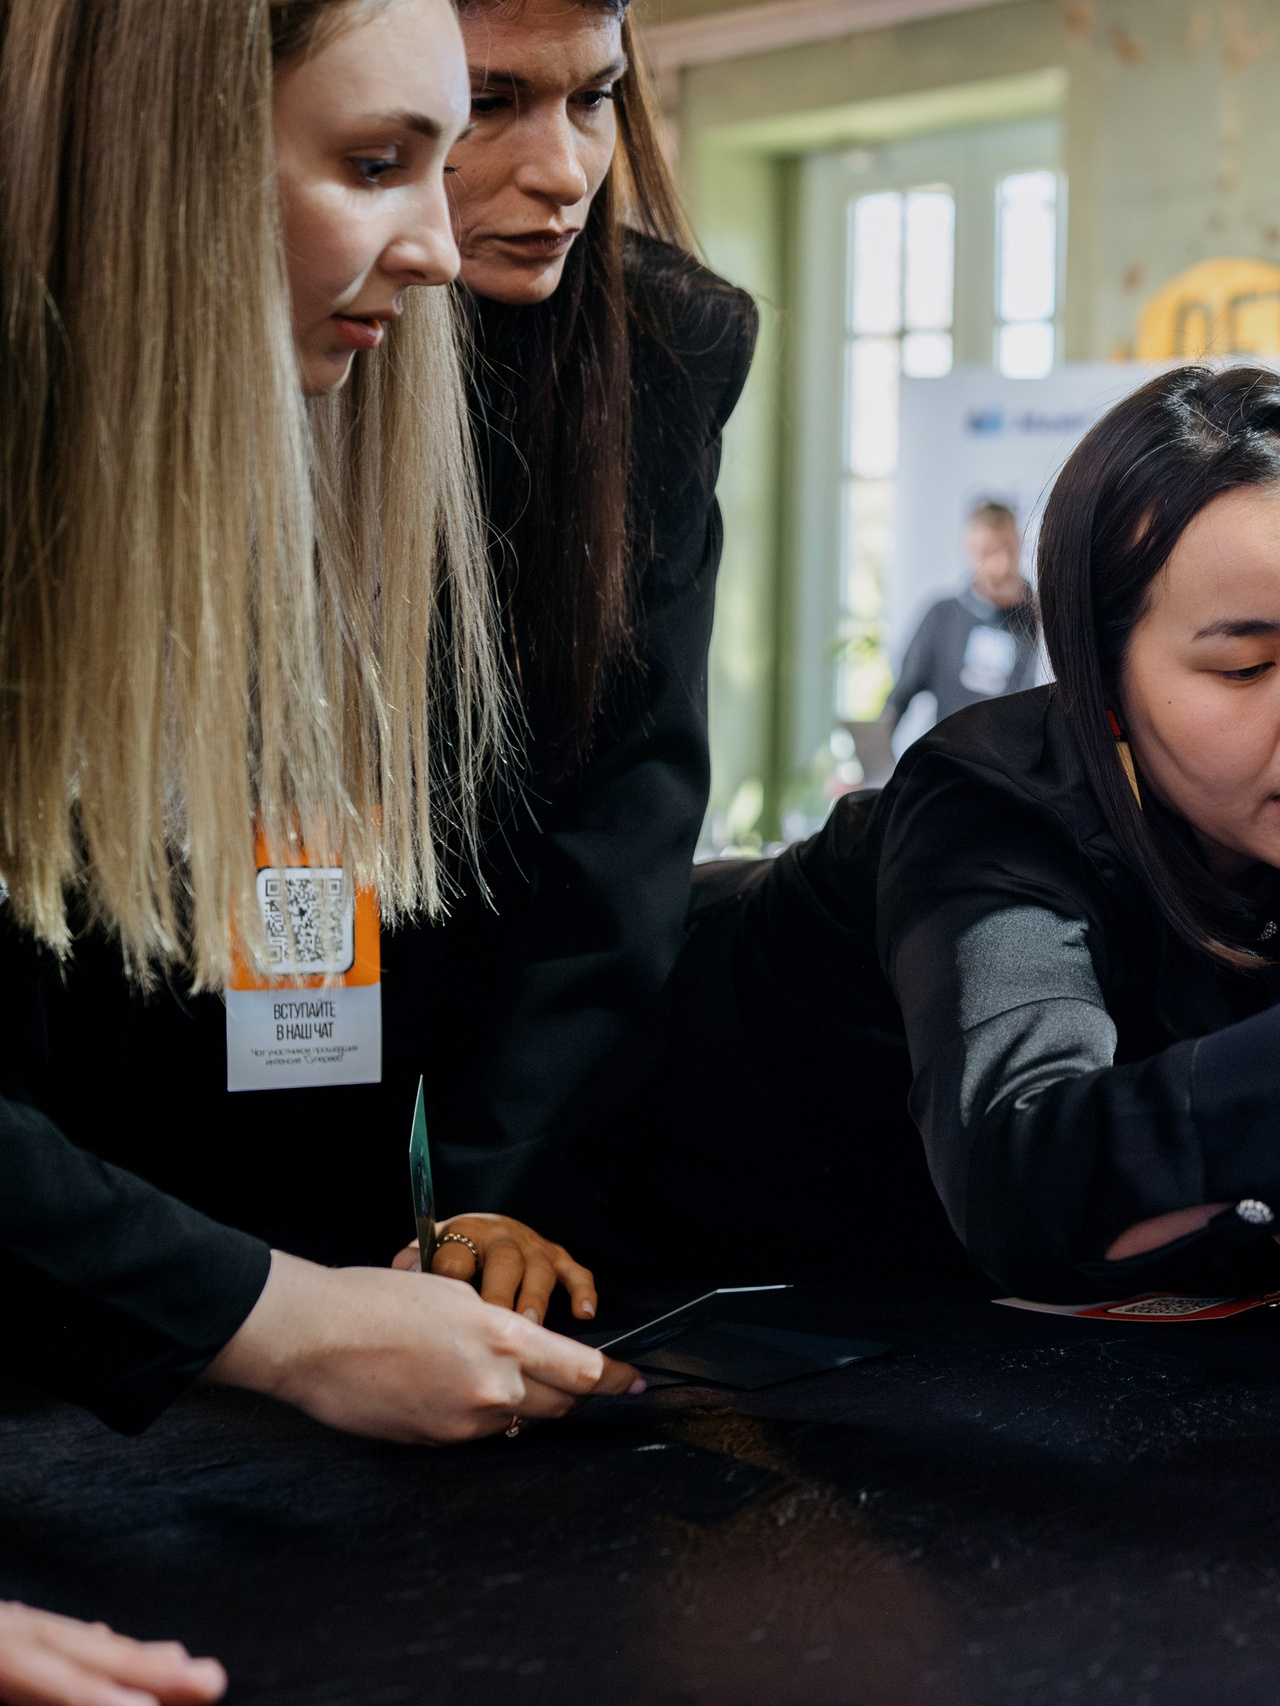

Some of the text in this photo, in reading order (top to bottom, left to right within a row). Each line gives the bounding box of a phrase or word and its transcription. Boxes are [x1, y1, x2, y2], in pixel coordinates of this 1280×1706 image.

[274, 1000, 336, 1019] ВСТУПАЙТЕ
[276, 1021, 334, 1041] В НАШ ЧАТ
